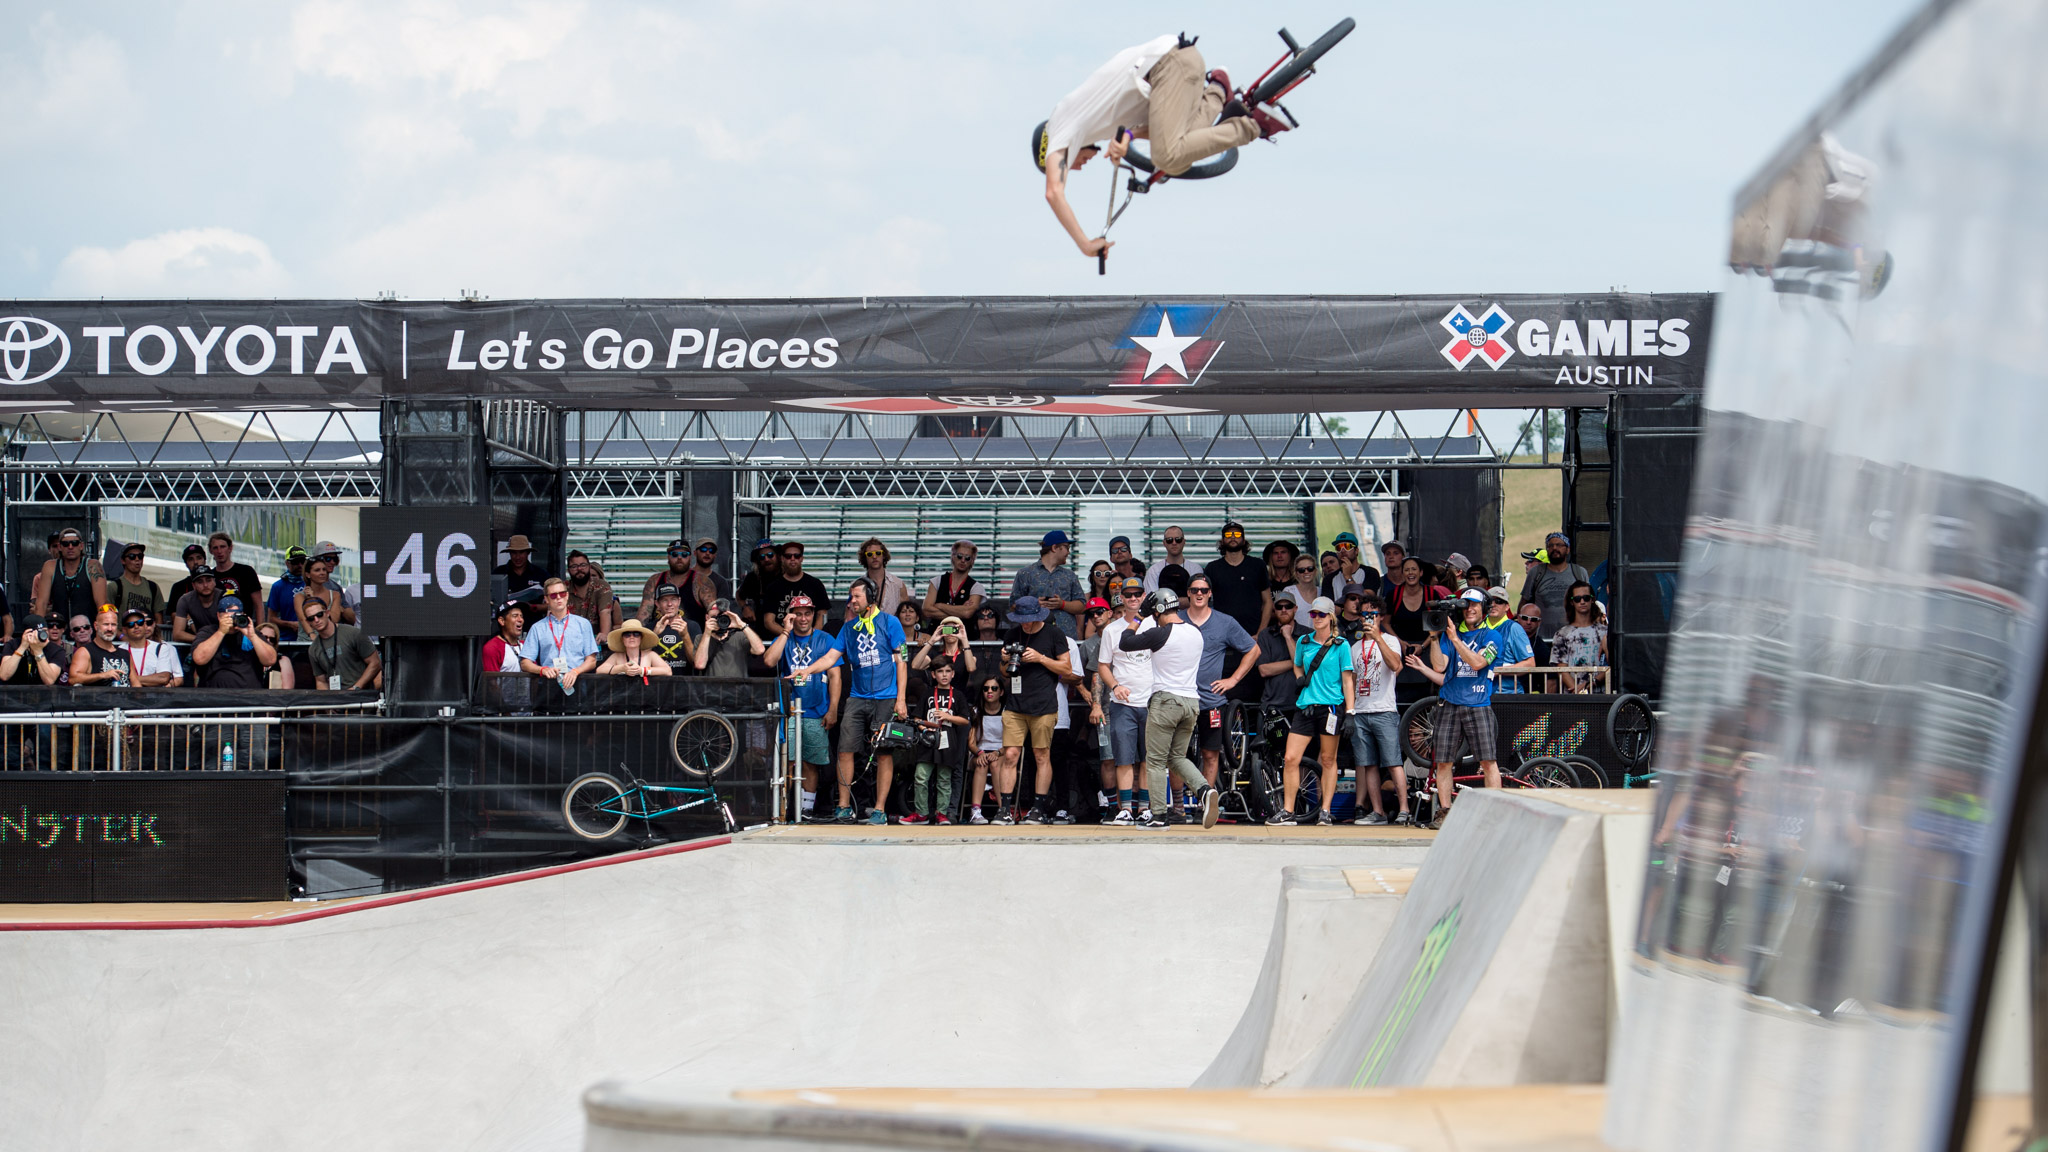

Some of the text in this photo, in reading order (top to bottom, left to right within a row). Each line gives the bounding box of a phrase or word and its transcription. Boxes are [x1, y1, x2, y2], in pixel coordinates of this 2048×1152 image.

[83, 325, 367, 375] TOYOTA
[584, 328, 653, 370] Go
[667, 328, 839, 370] Places
[1517, 318, 1690, 357] GAMES
[1555, 365, 1653, 385] AUSTIN
[364, 533, 477, 598] :46
[1472, 684, 1485, 693] 102
